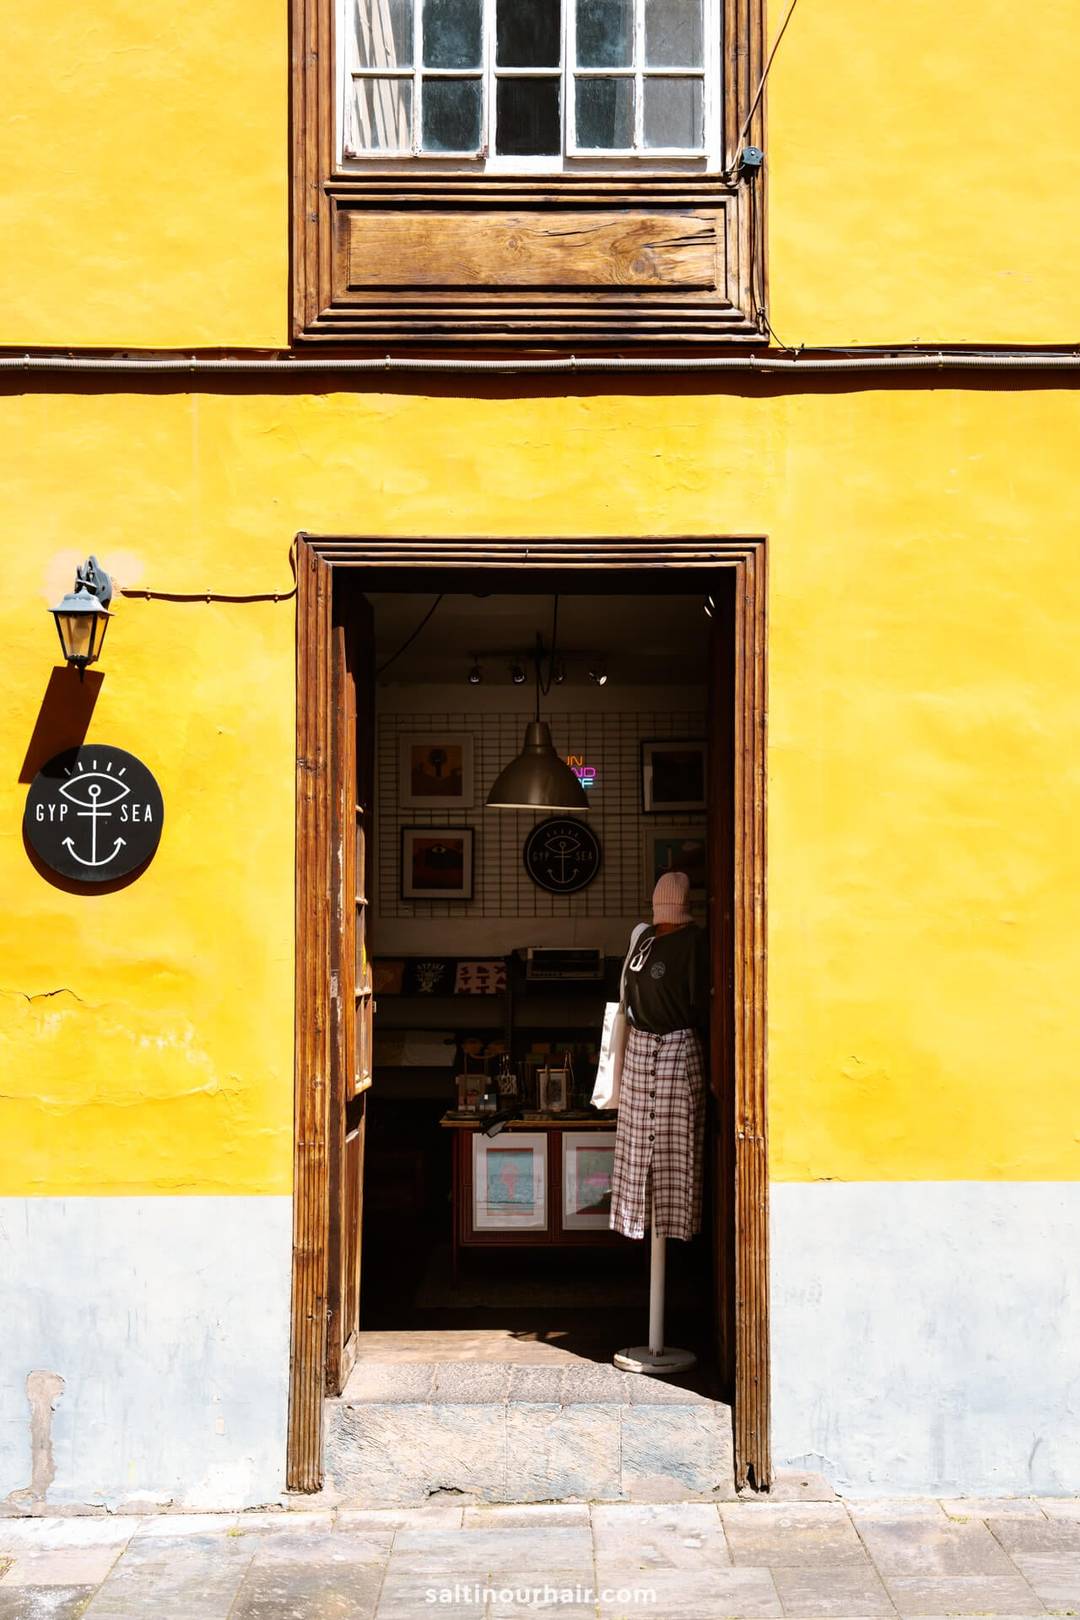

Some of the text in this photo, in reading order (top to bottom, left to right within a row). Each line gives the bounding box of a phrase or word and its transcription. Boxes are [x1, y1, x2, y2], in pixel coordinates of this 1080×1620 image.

[570, 767, 597, 779] ND
[36, 803, 153, 823] GYP SEA
[575, 850, 593, 862] SEA
